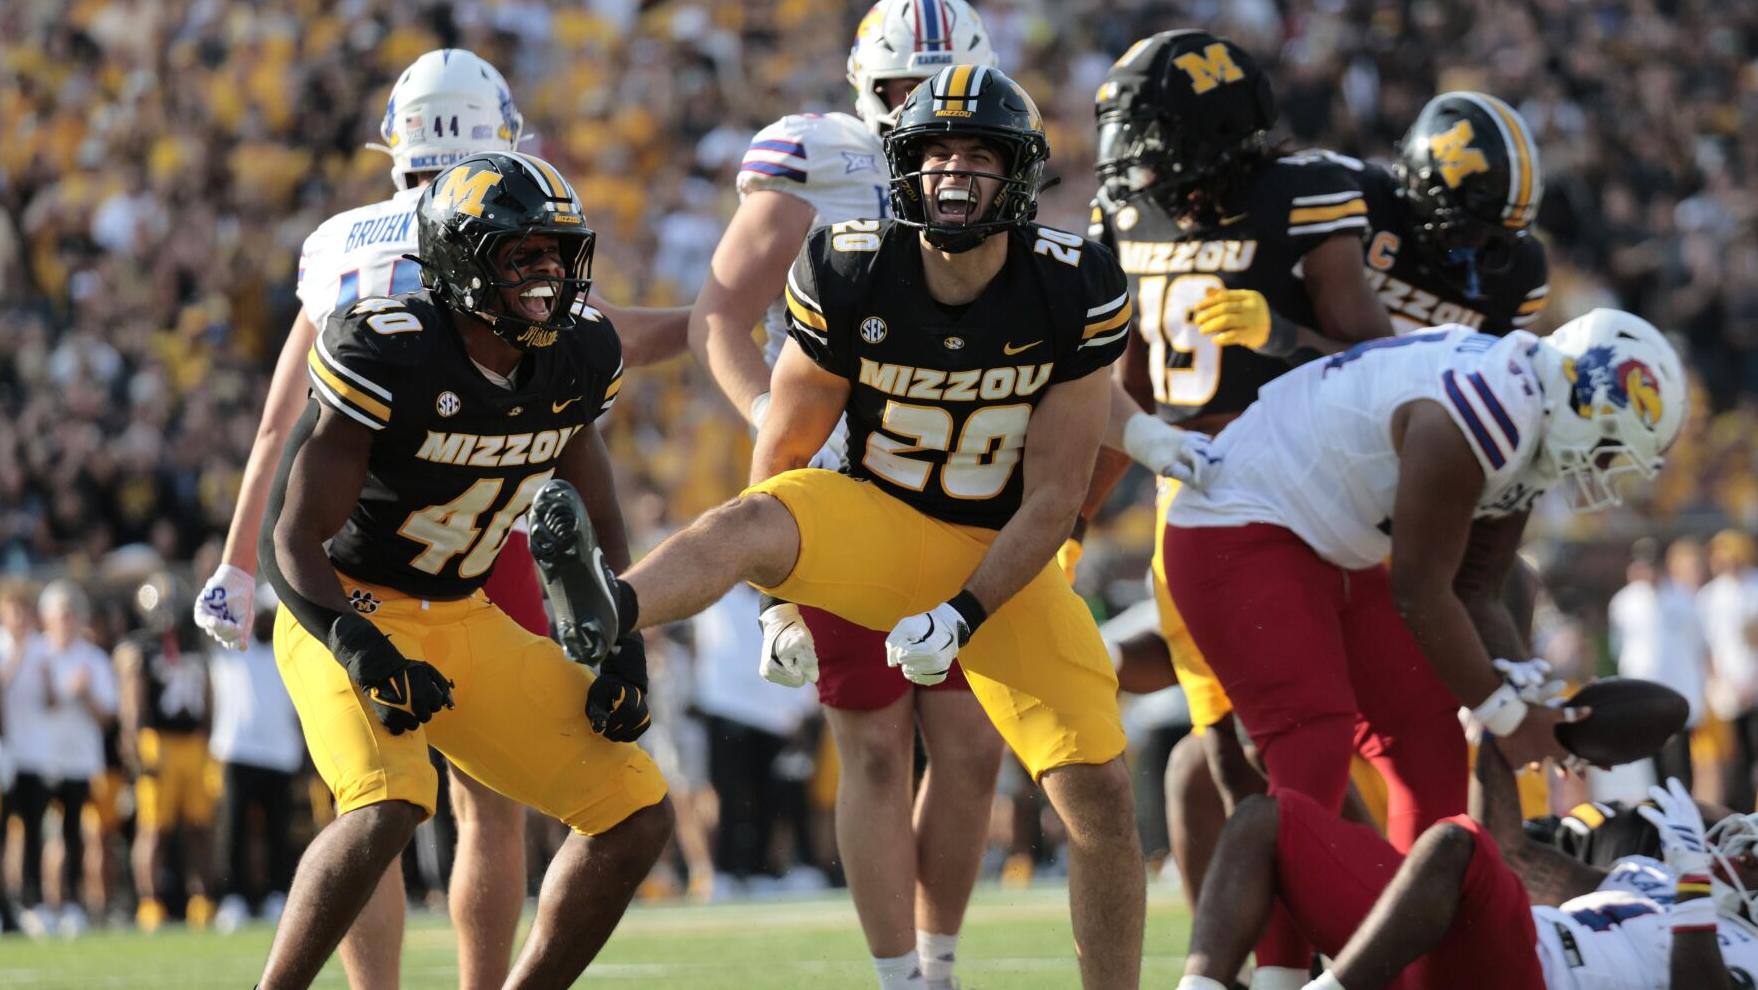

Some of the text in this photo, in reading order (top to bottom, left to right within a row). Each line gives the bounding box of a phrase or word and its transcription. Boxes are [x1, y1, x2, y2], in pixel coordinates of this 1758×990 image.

[1174, 43, 1243, 94] M
[433, 115, 459, 138] 44
[935, 110, 972, 118] MIZZOU
[1431, 119, 1488, 188] M
[432, 167, 504, 218] M
[345, 212, 417, 253] BRUHN
[832, 220, 880, 252] 20
[1034, 227, 1084, 268] 20
[1368, 231, 1400, 270] C
[351, 299, 424, 335] 40
[1364, 267, 1487, 332] IZZOU
[861, 317, 886, 342] SEC
[859, 357, 1054, 401] MIZZOU
[438, 392, 460, 416] SEC
[862, 400, 1033, 500] 20
